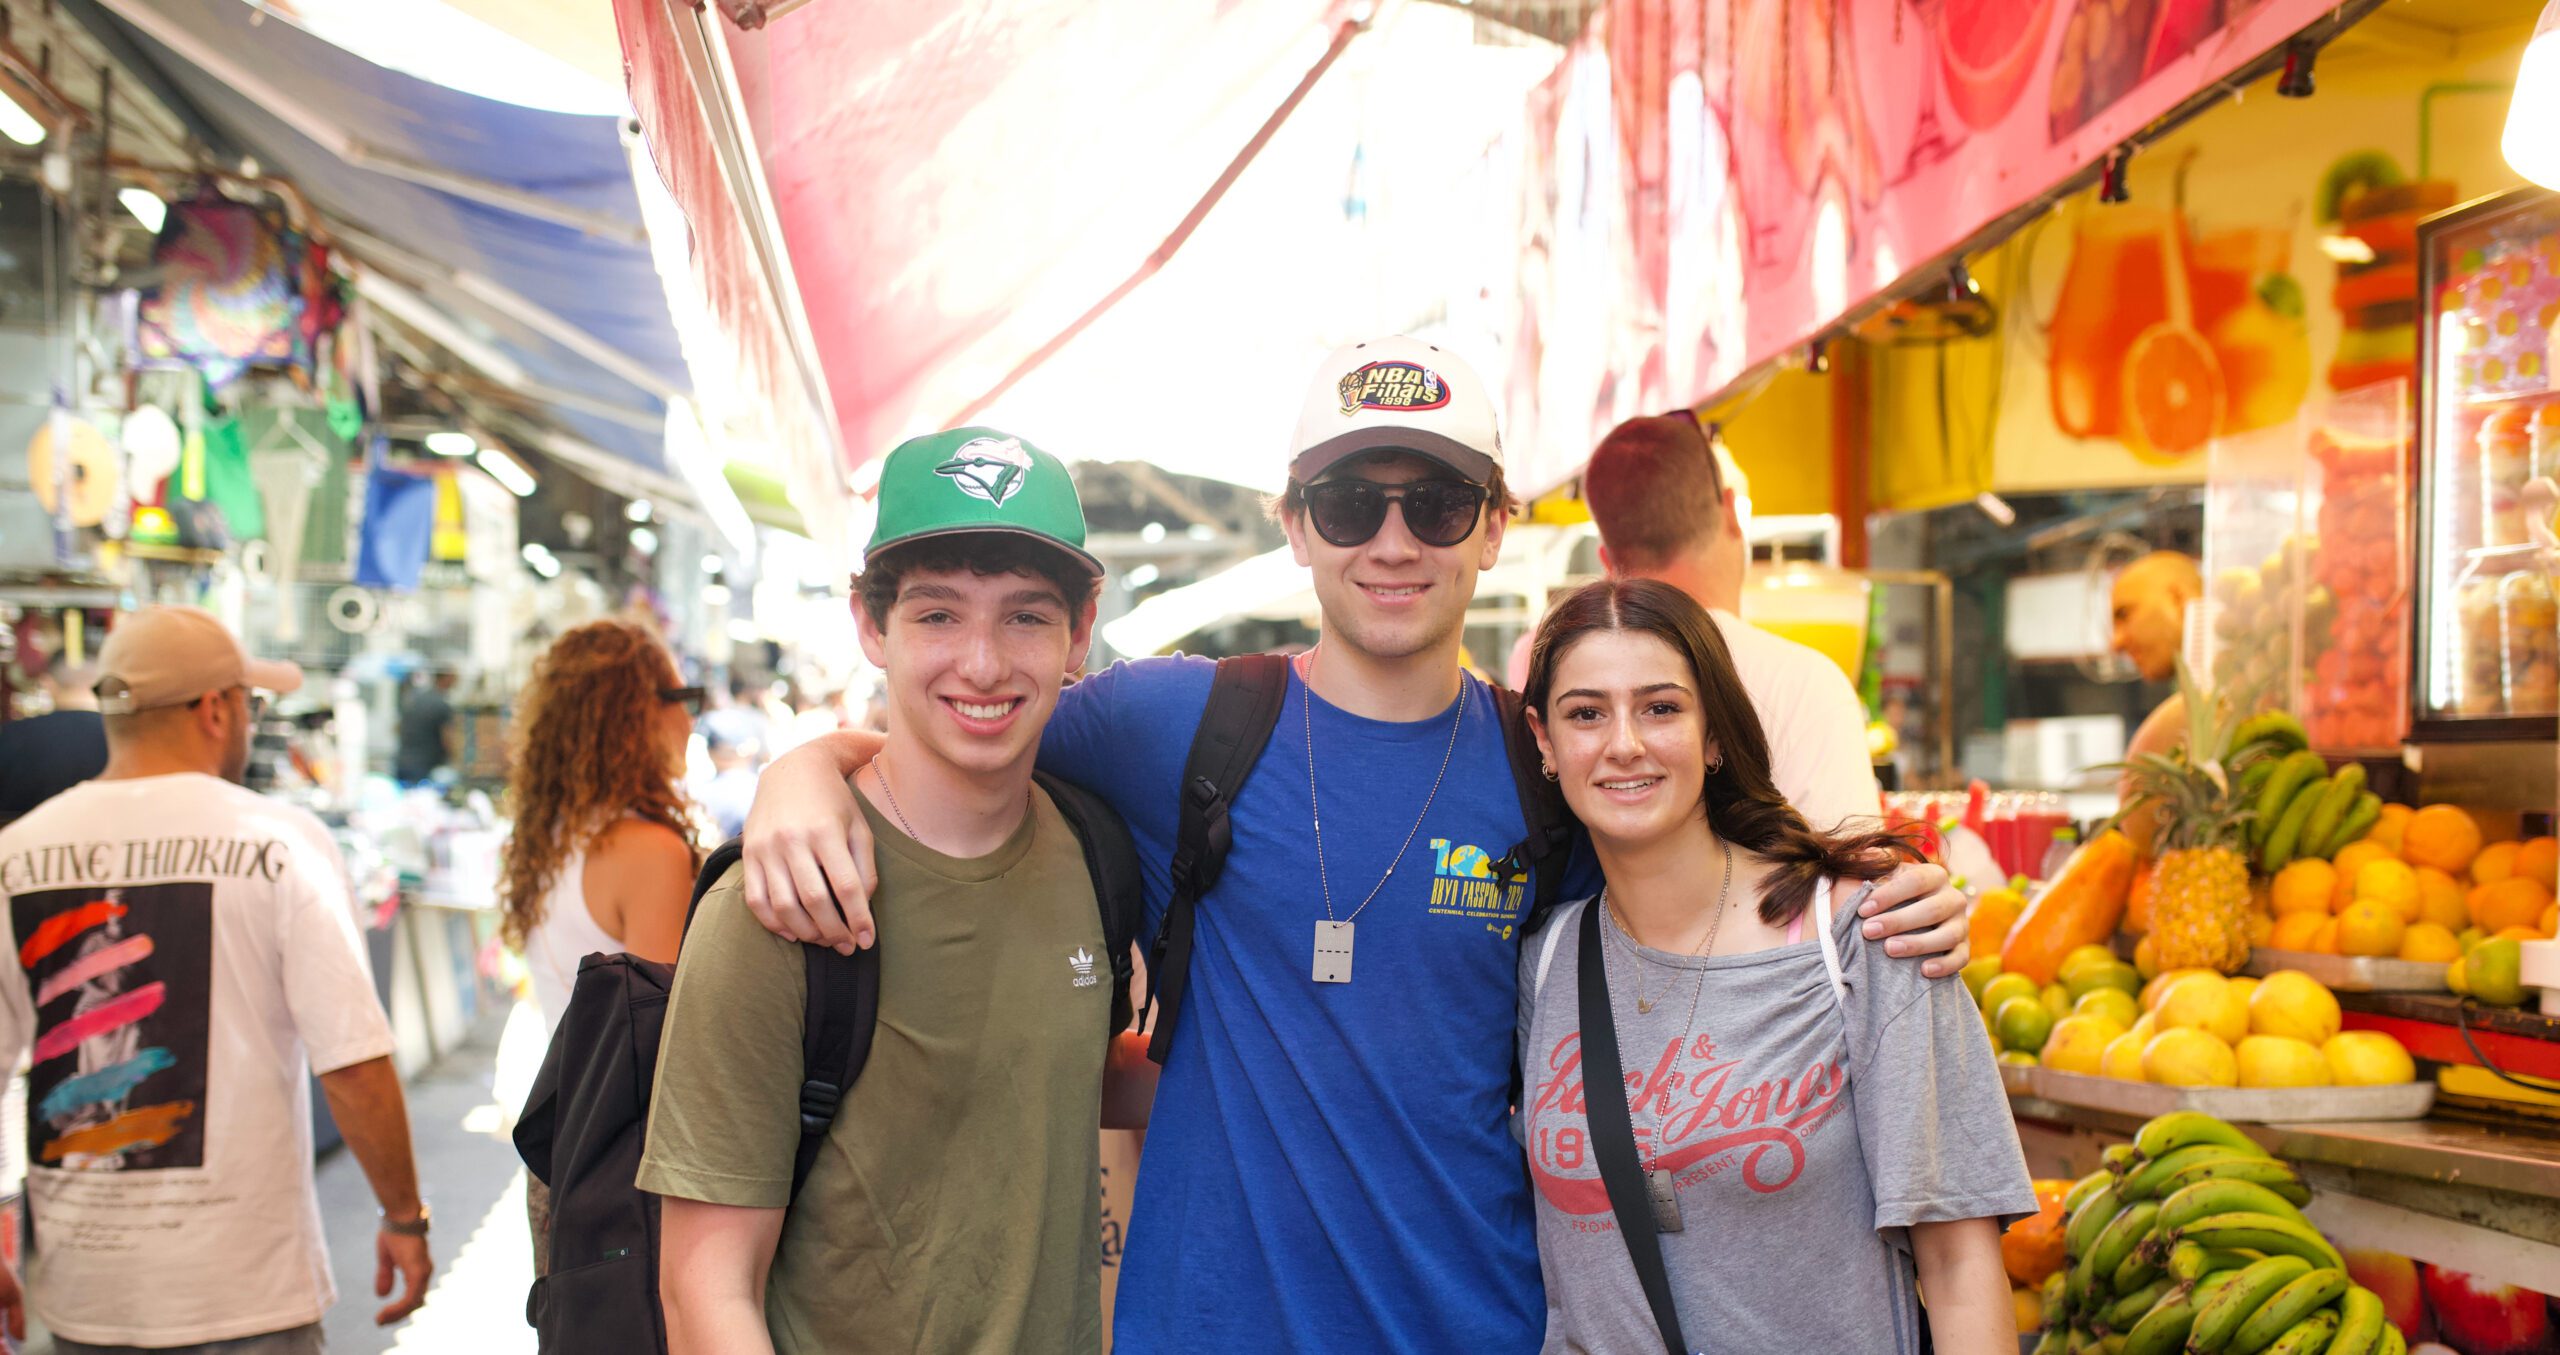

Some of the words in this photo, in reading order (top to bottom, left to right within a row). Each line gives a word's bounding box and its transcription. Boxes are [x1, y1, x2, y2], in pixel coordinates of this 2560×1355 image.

[1366, 367, 1423, 384] NBA
[1360, 383, 1439, 403] Finals
[1379, 397, 1412, 406] 1998
[121, 836, 289, 884] THINKING
[1430, 877, 1459, 907] BBYO
[1428, 908, 1464, 916] CENTENNIAL
[1690, 1033, 1717, 1060] &
[1661, 1052, 1844, 1144] Jones
[1800, 1100, 1848, 1138] ORIGINALS
[1572, 1220, 1615, 1233] FROM
[1675, 1153, 1738, 1194] PRESENT
